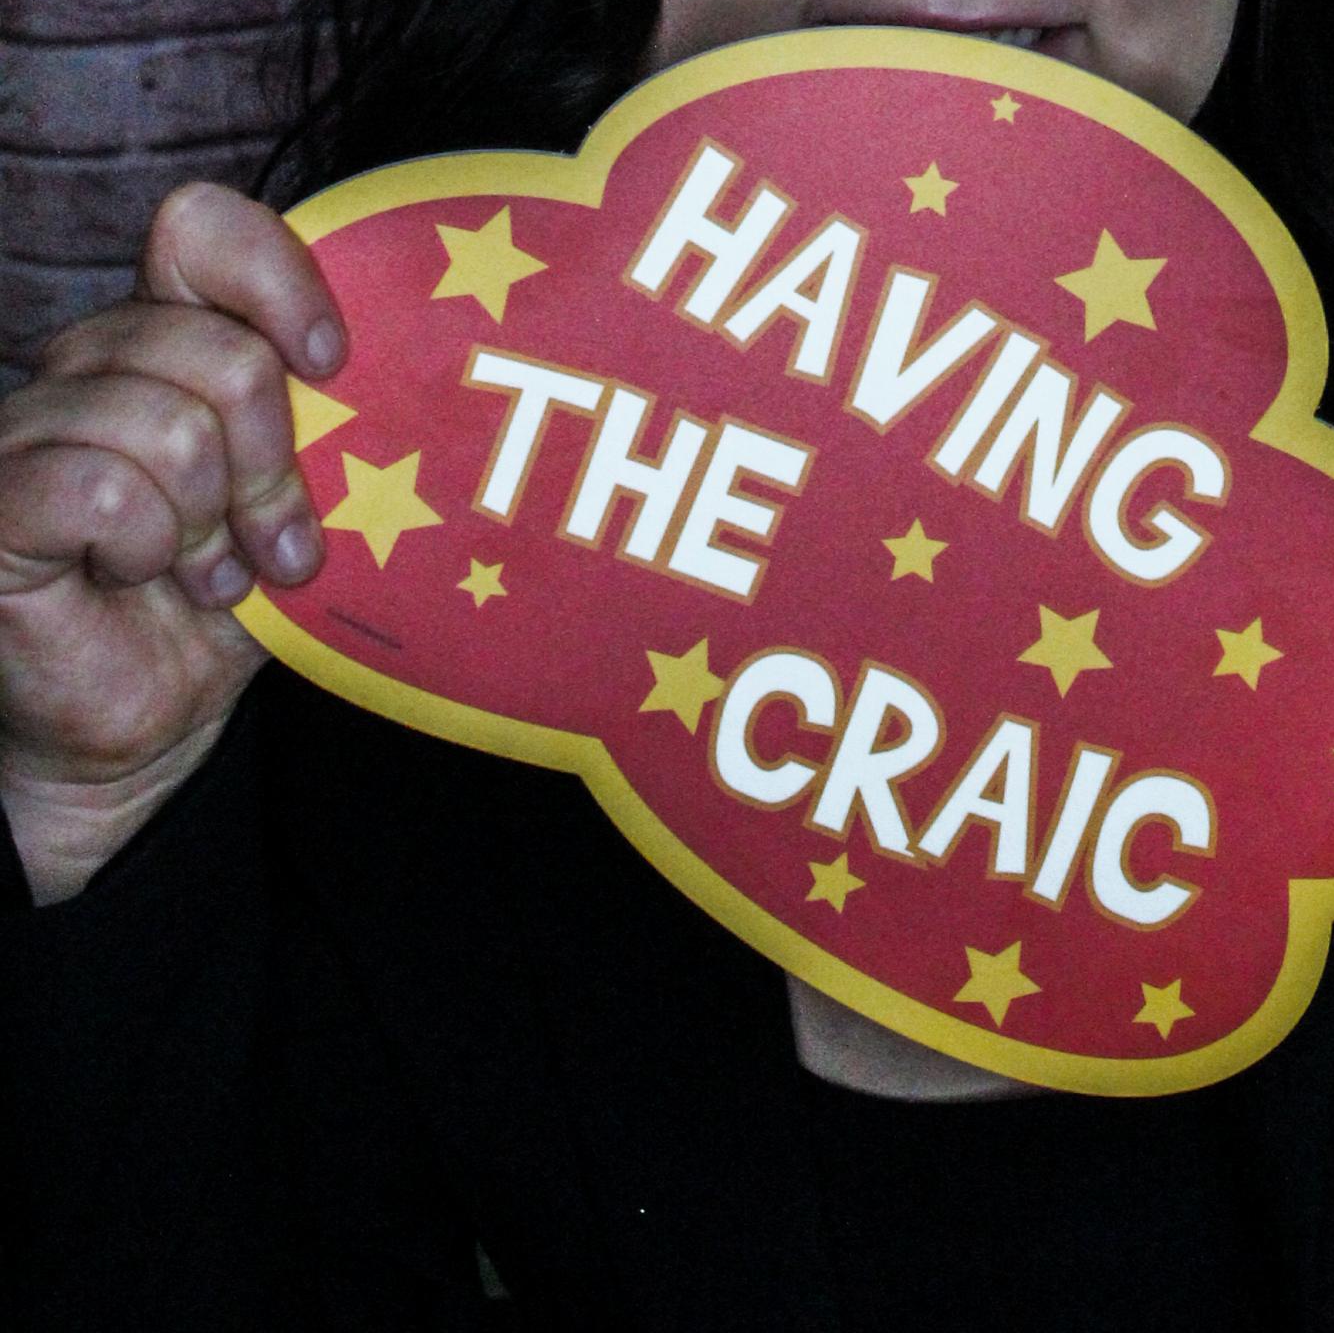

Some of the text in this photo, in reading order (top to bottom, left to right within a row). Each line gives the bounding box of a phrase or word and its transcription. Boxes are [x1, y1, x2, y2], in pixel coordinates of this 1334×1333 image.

[464, 347, 815, 603] THE
[625, 139, 1232, 587] HAVING
[709, 649, 1216, 928] CRAIC
